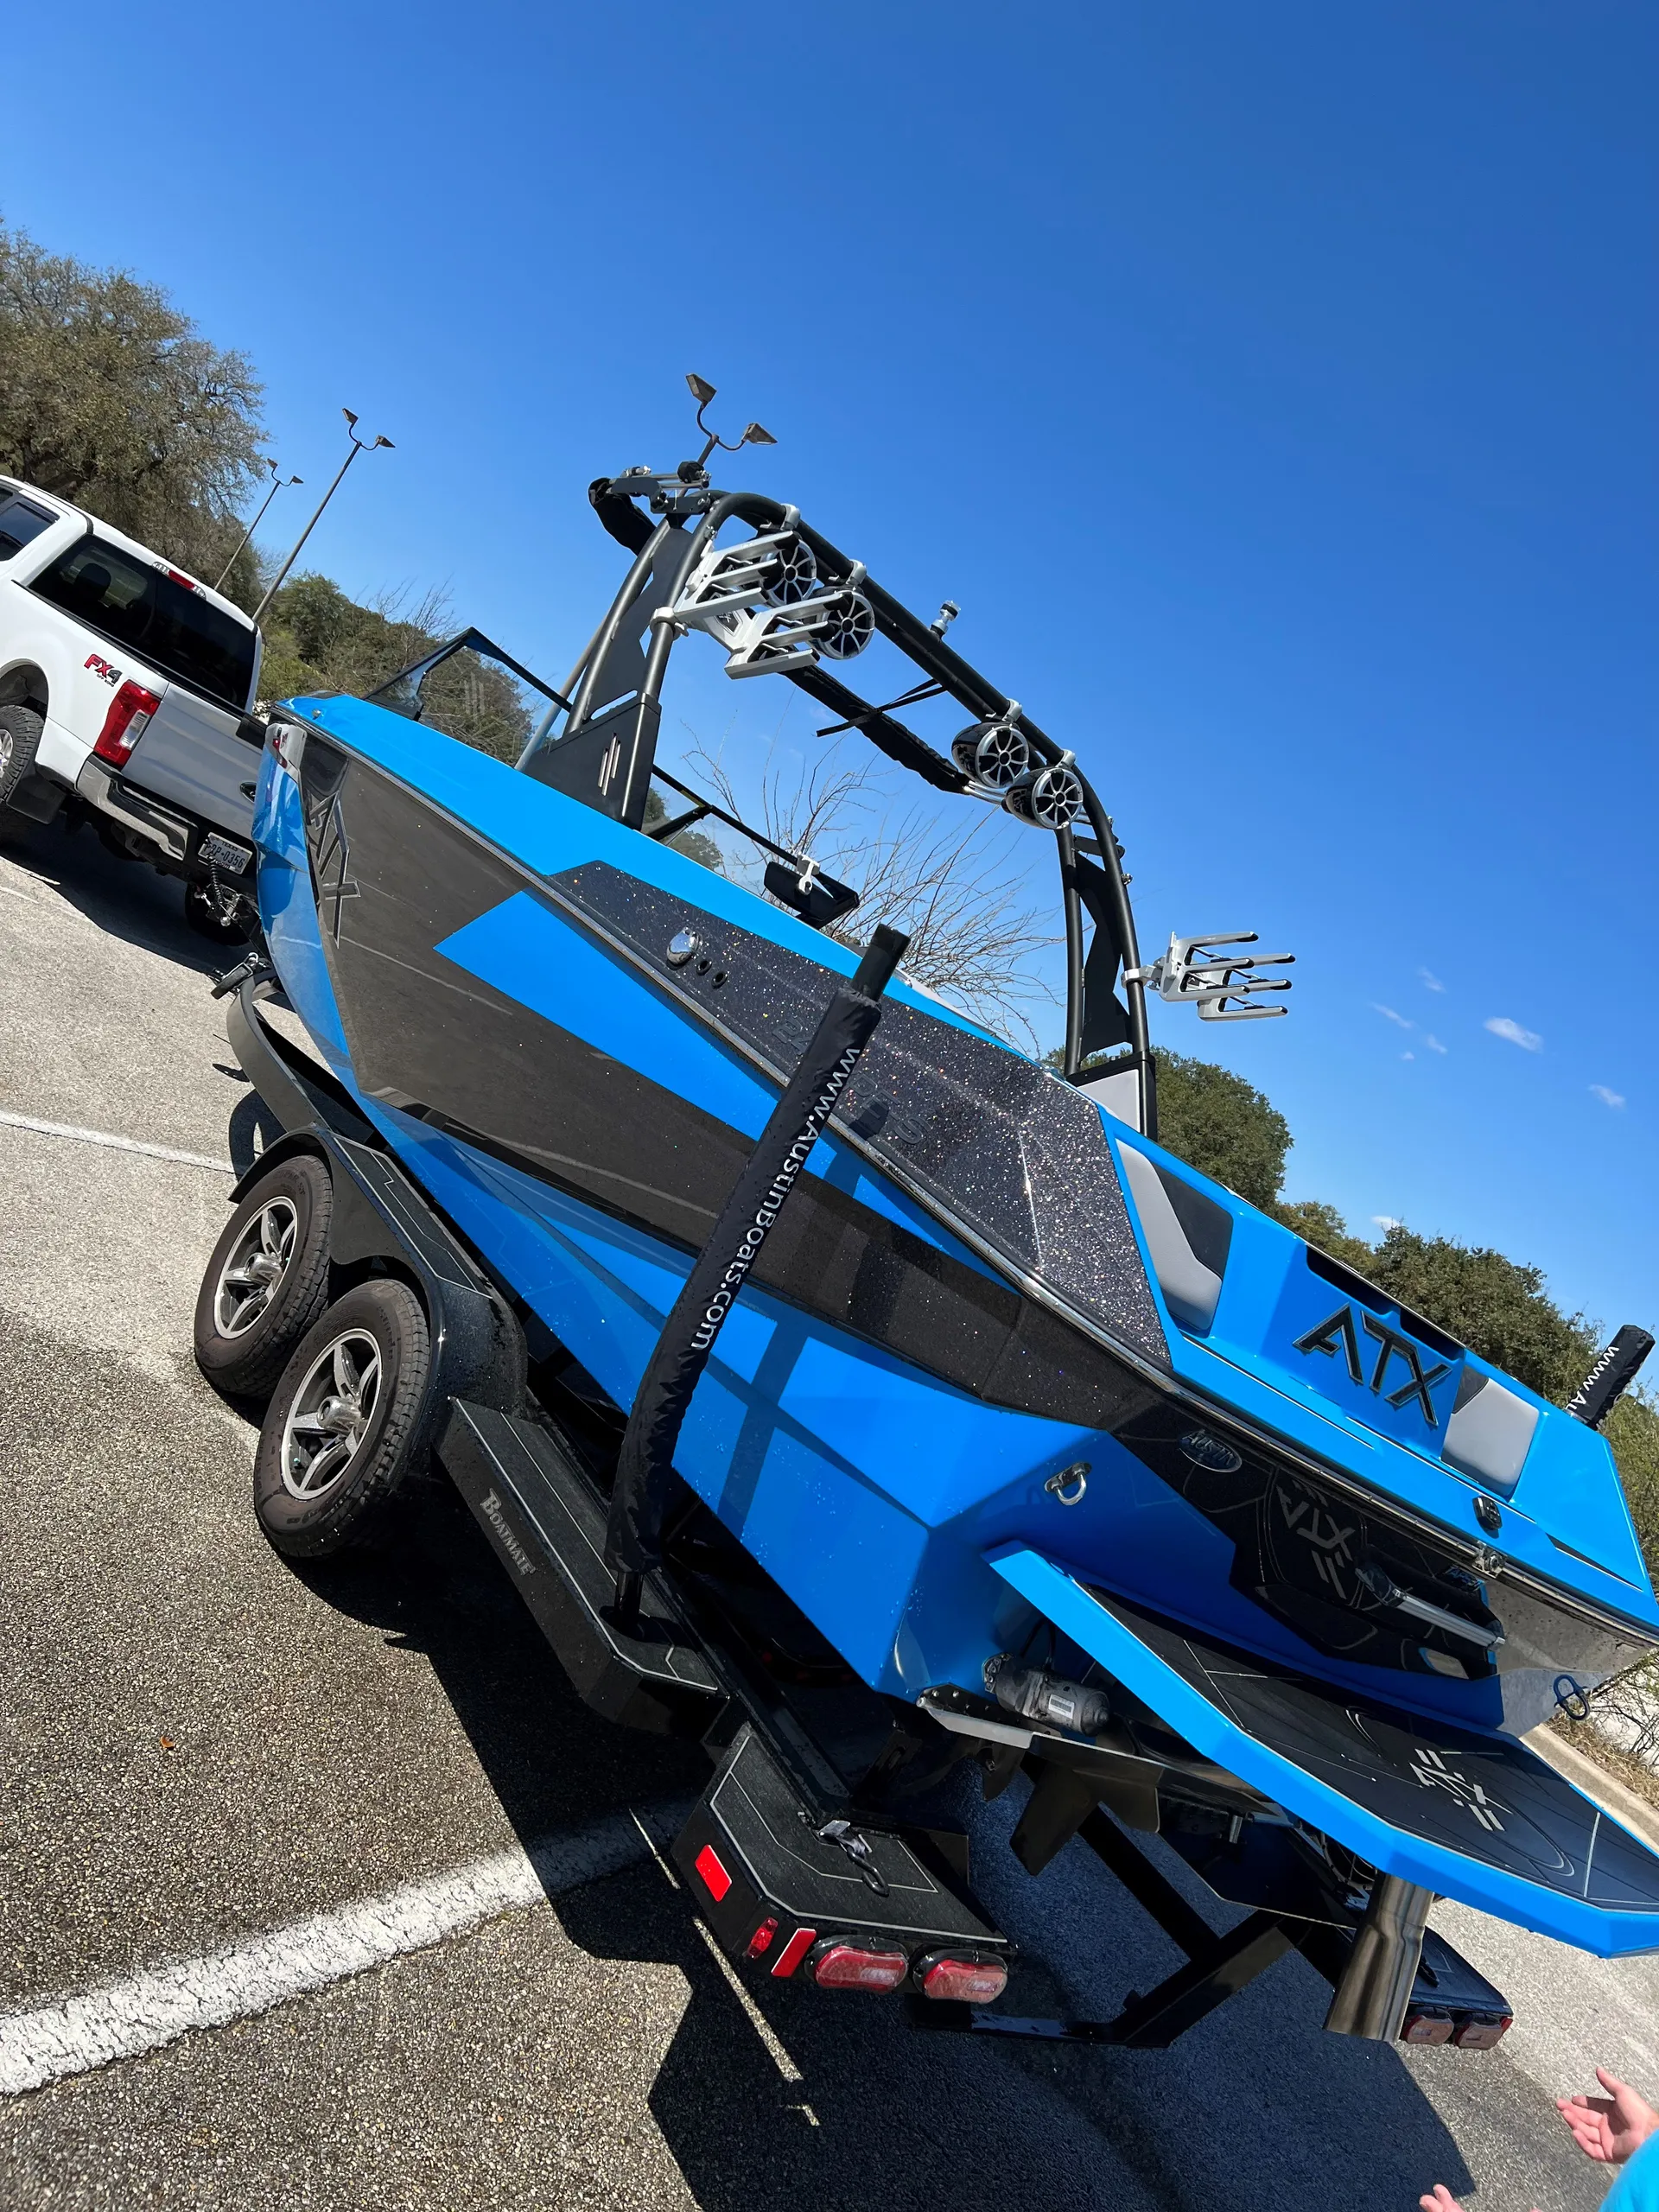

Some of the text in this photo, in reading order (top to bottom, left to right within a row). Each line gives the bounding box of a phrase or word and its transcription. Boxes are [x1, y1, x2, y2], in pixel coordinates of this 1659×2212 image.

[84, 653, 123, 684] FX4
[691, 1047, 861, 1350] www.AustinBoats.com
[1293, 1302, 1452, 1426] ATX
